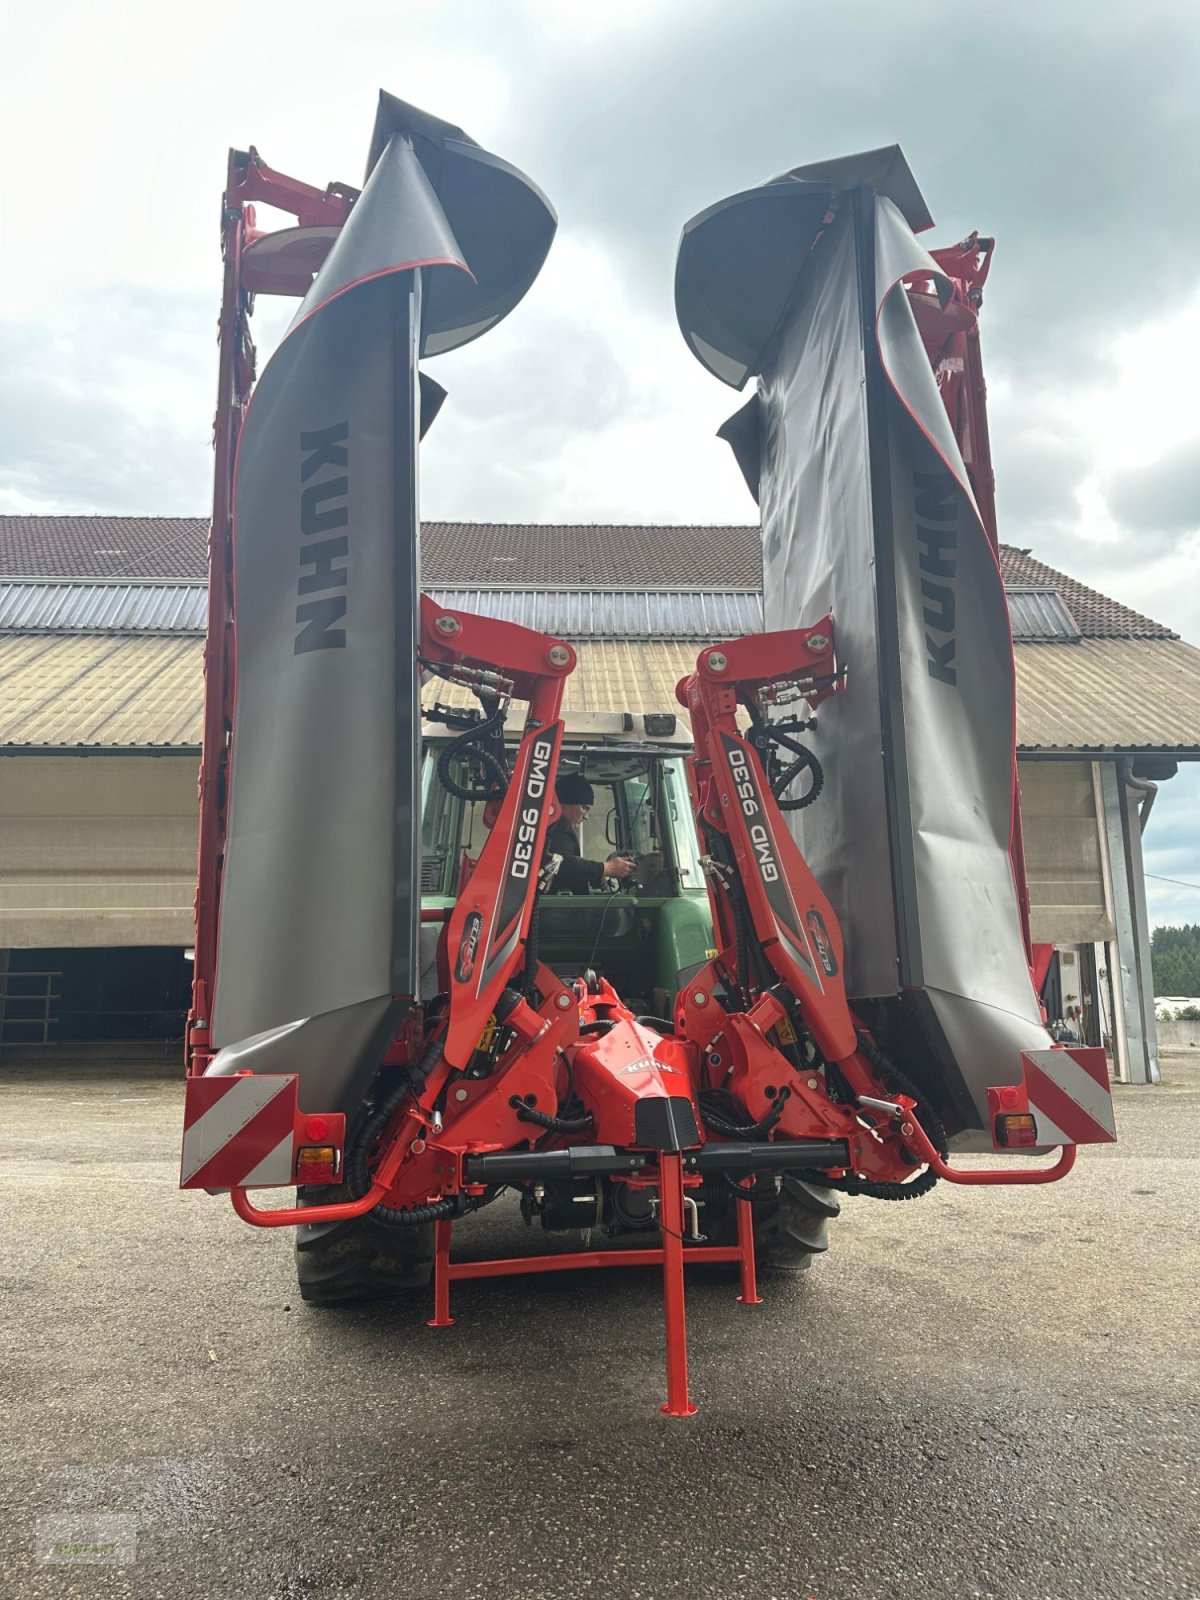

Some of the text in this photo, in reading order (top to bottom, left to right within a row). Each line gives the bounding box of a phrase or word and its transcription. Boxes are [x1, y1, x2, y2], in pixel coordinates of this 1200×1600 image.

[294, 420, 348, 656] KUHN
[913, 471, 958, 687] KUHN
[511, 741, 551, 879] GMD 9530
[728, 749, 779, 882] GMD 9530
[627, 1060, 673, 1072] KUHN
